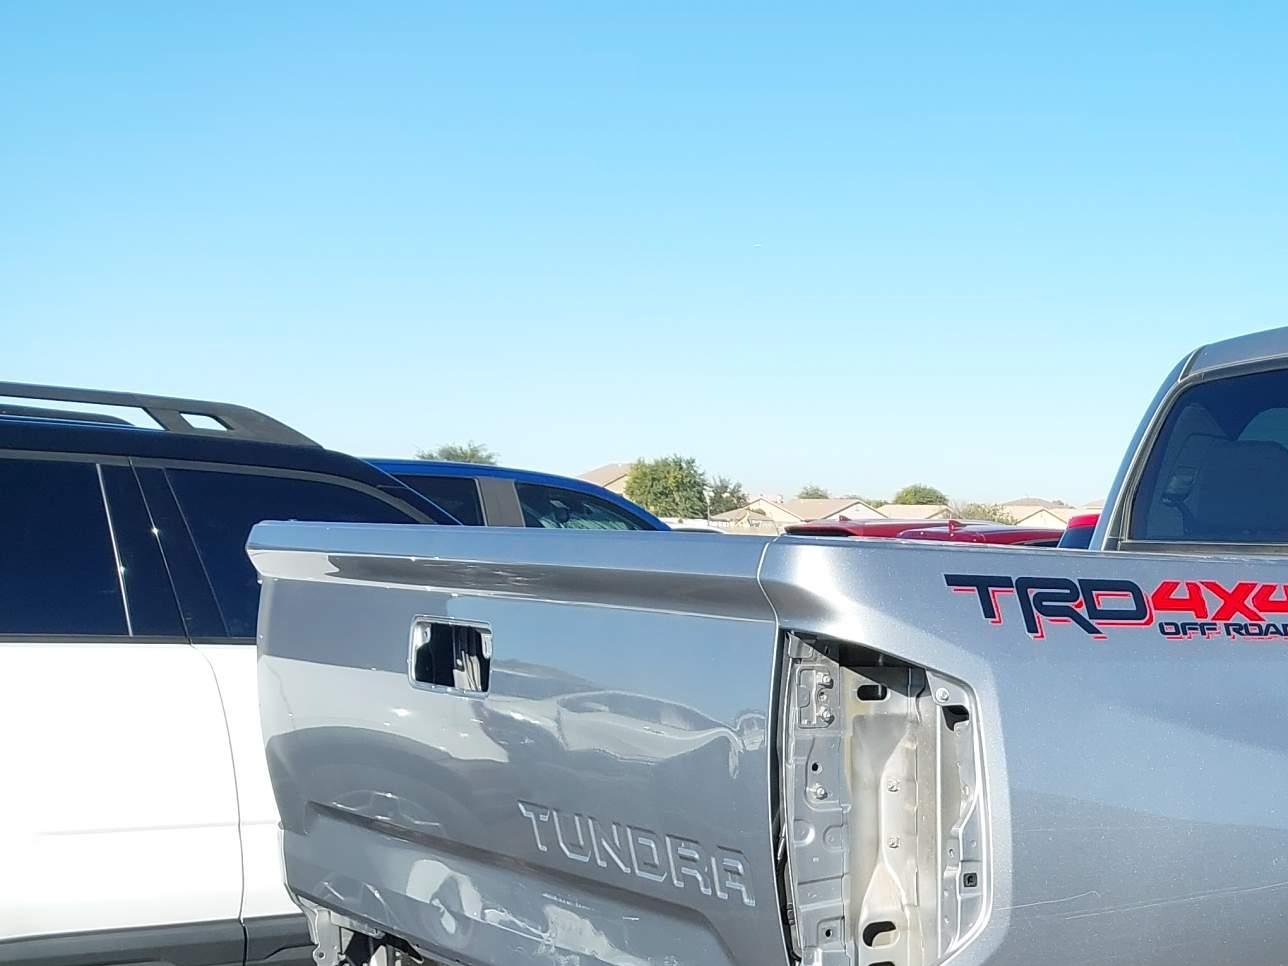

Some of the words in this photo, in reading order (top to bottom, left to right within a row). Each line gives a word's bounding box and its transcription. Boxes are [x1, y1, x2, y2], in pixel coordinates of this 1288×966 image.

[943, 573, 1153, 639] TRD
[1158, 620, 1221, 641] OFF
[517, 799, 755, 906] TUNDRA
